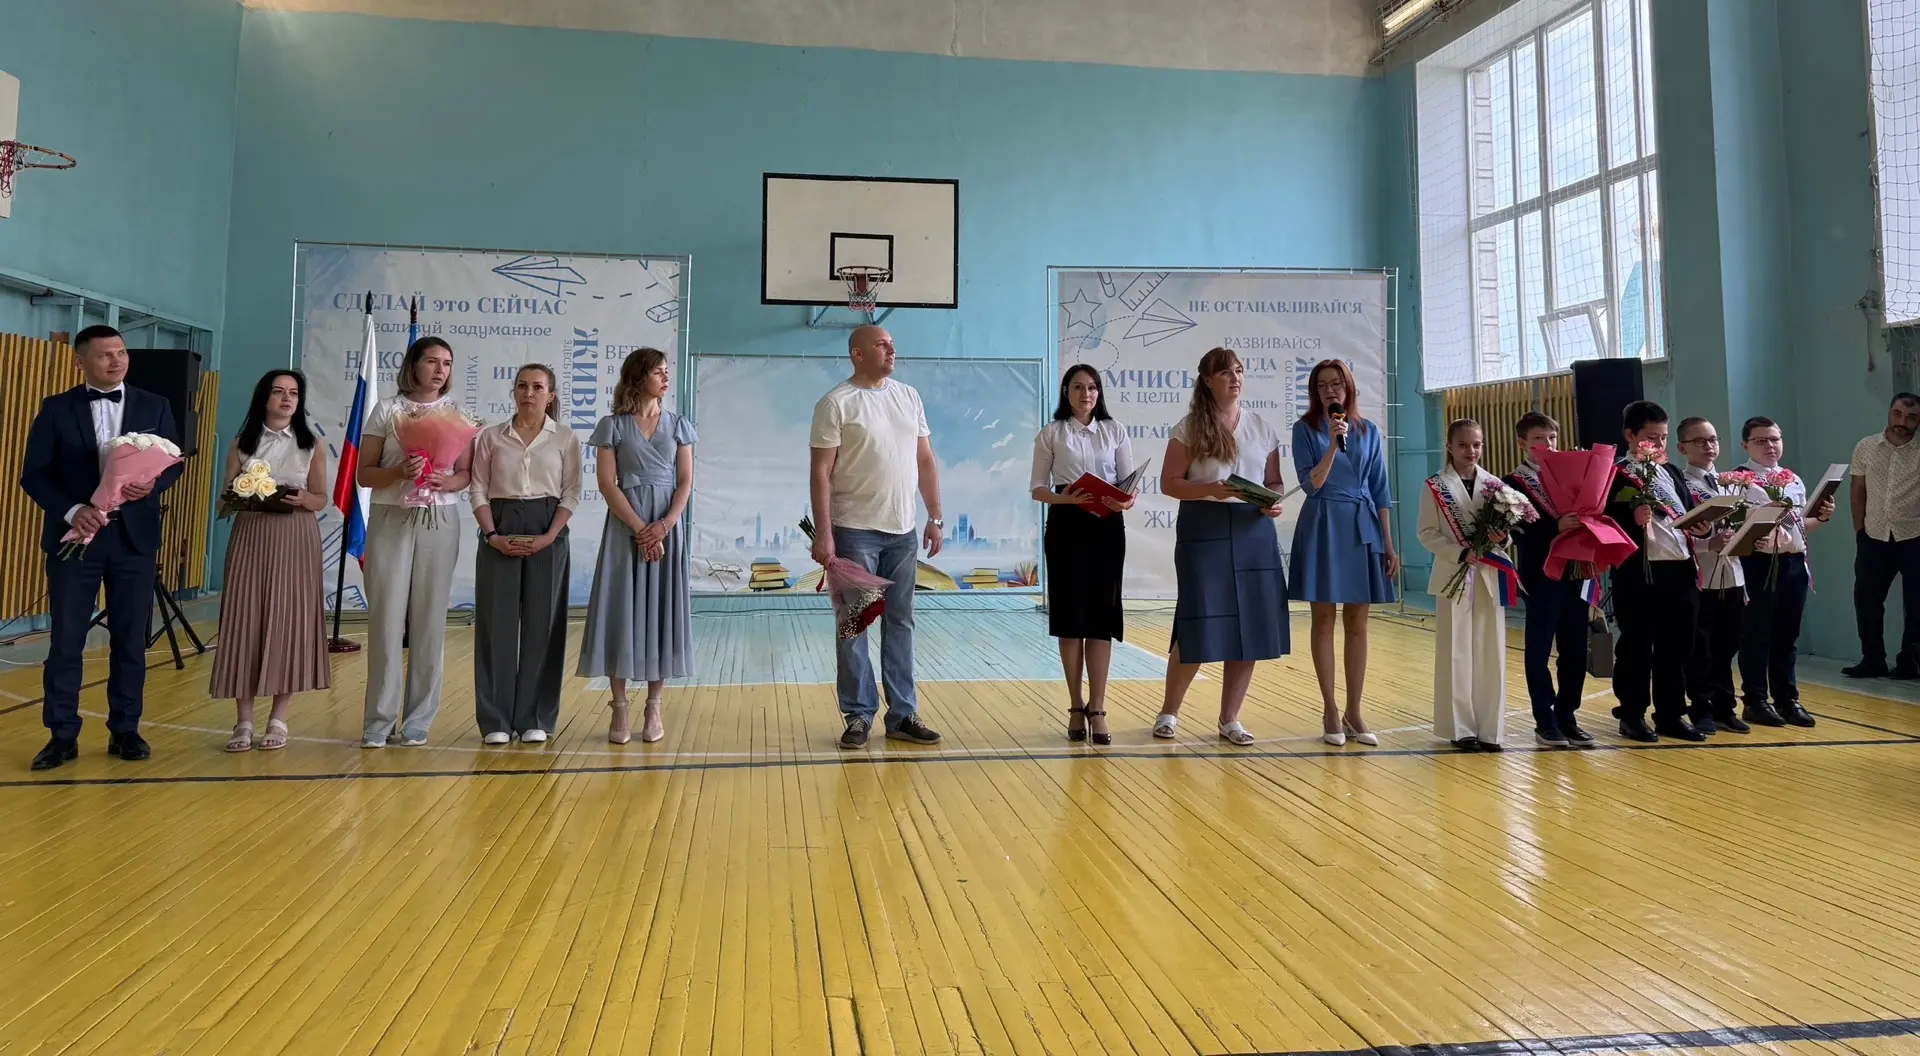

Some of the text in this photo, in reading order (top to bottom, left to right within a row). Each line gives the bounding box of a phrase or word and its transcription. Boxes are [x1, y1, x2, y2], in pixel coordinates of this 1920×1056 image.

[433, 300, 470, 312] это
[477, 294, 567, 315] СЕЙЧАС
[1188, 299, 1363, 314] НЕ ОСТАНАВЛИВАЙСЯ
[450, 324, 552, 339] задуманное
[1224, 336, 1321, 350] РАЗВИВАЙСЯ
[571, 326, 599, 430] ЖИВИ
[1104, 369, 1195, 388] МЧИСЬ
[1136, 391, 1181, 404] цели
